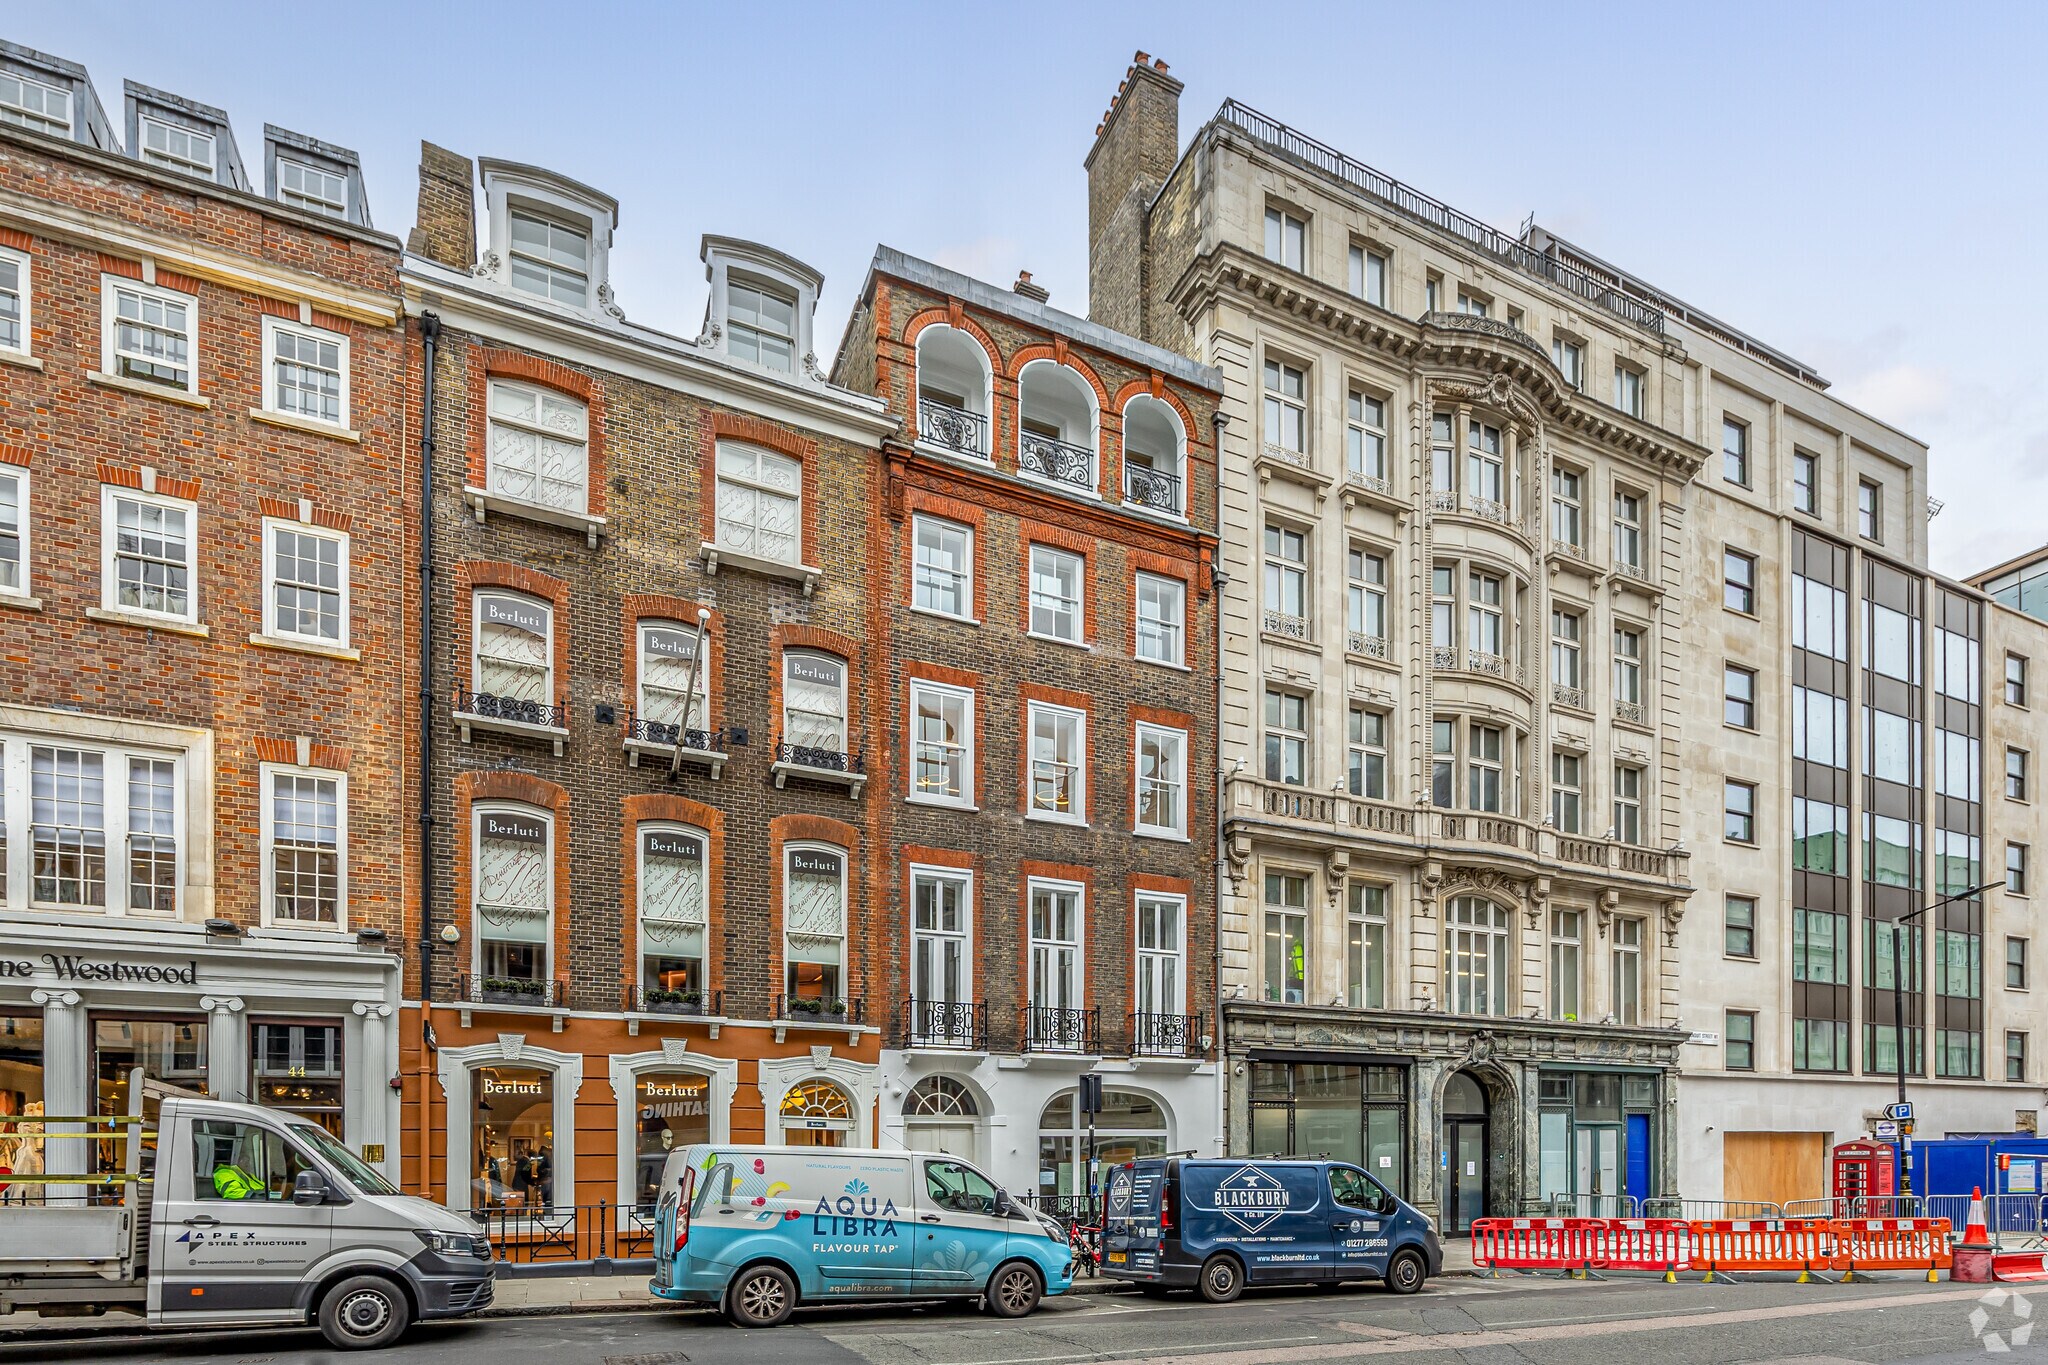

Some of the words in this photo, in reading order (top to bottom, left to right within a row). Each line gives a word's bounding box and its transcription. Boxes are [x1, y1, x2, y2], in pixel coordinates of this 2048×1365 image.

[489, 604, 540, 626] Berluti
[651, 636, 696, 656] Berluti
[794, 663, 835, 681] Berluti
[488, 819, 540, 837] Berluti
[651, 838, 696, 855] Berluti
[795, 856, 836, 871] Berluti
[41, 953, 198, 985] Westwood
[288, 1066, 306, 1077] 44
[483, 1078, 542, 1094] Berluti
[646, 1081, 699, 1097] Berluti
[1898, 1106, 1908, 1116] P
[815, 1195, 899, 1216] AQUA
[1214, 1191, 1289, 1206] BLACKBURN
[813, 1215, 898, 1237] LIBRA
[813, 1243, 869, 1253] FLAVOUR
[1346, 1239, 1364, 1247] 01277
[1257, 1253, 1320, 1262] www.blackburnltd.co.uk
[828, 1283, 893, 1294] aqualibra.com
